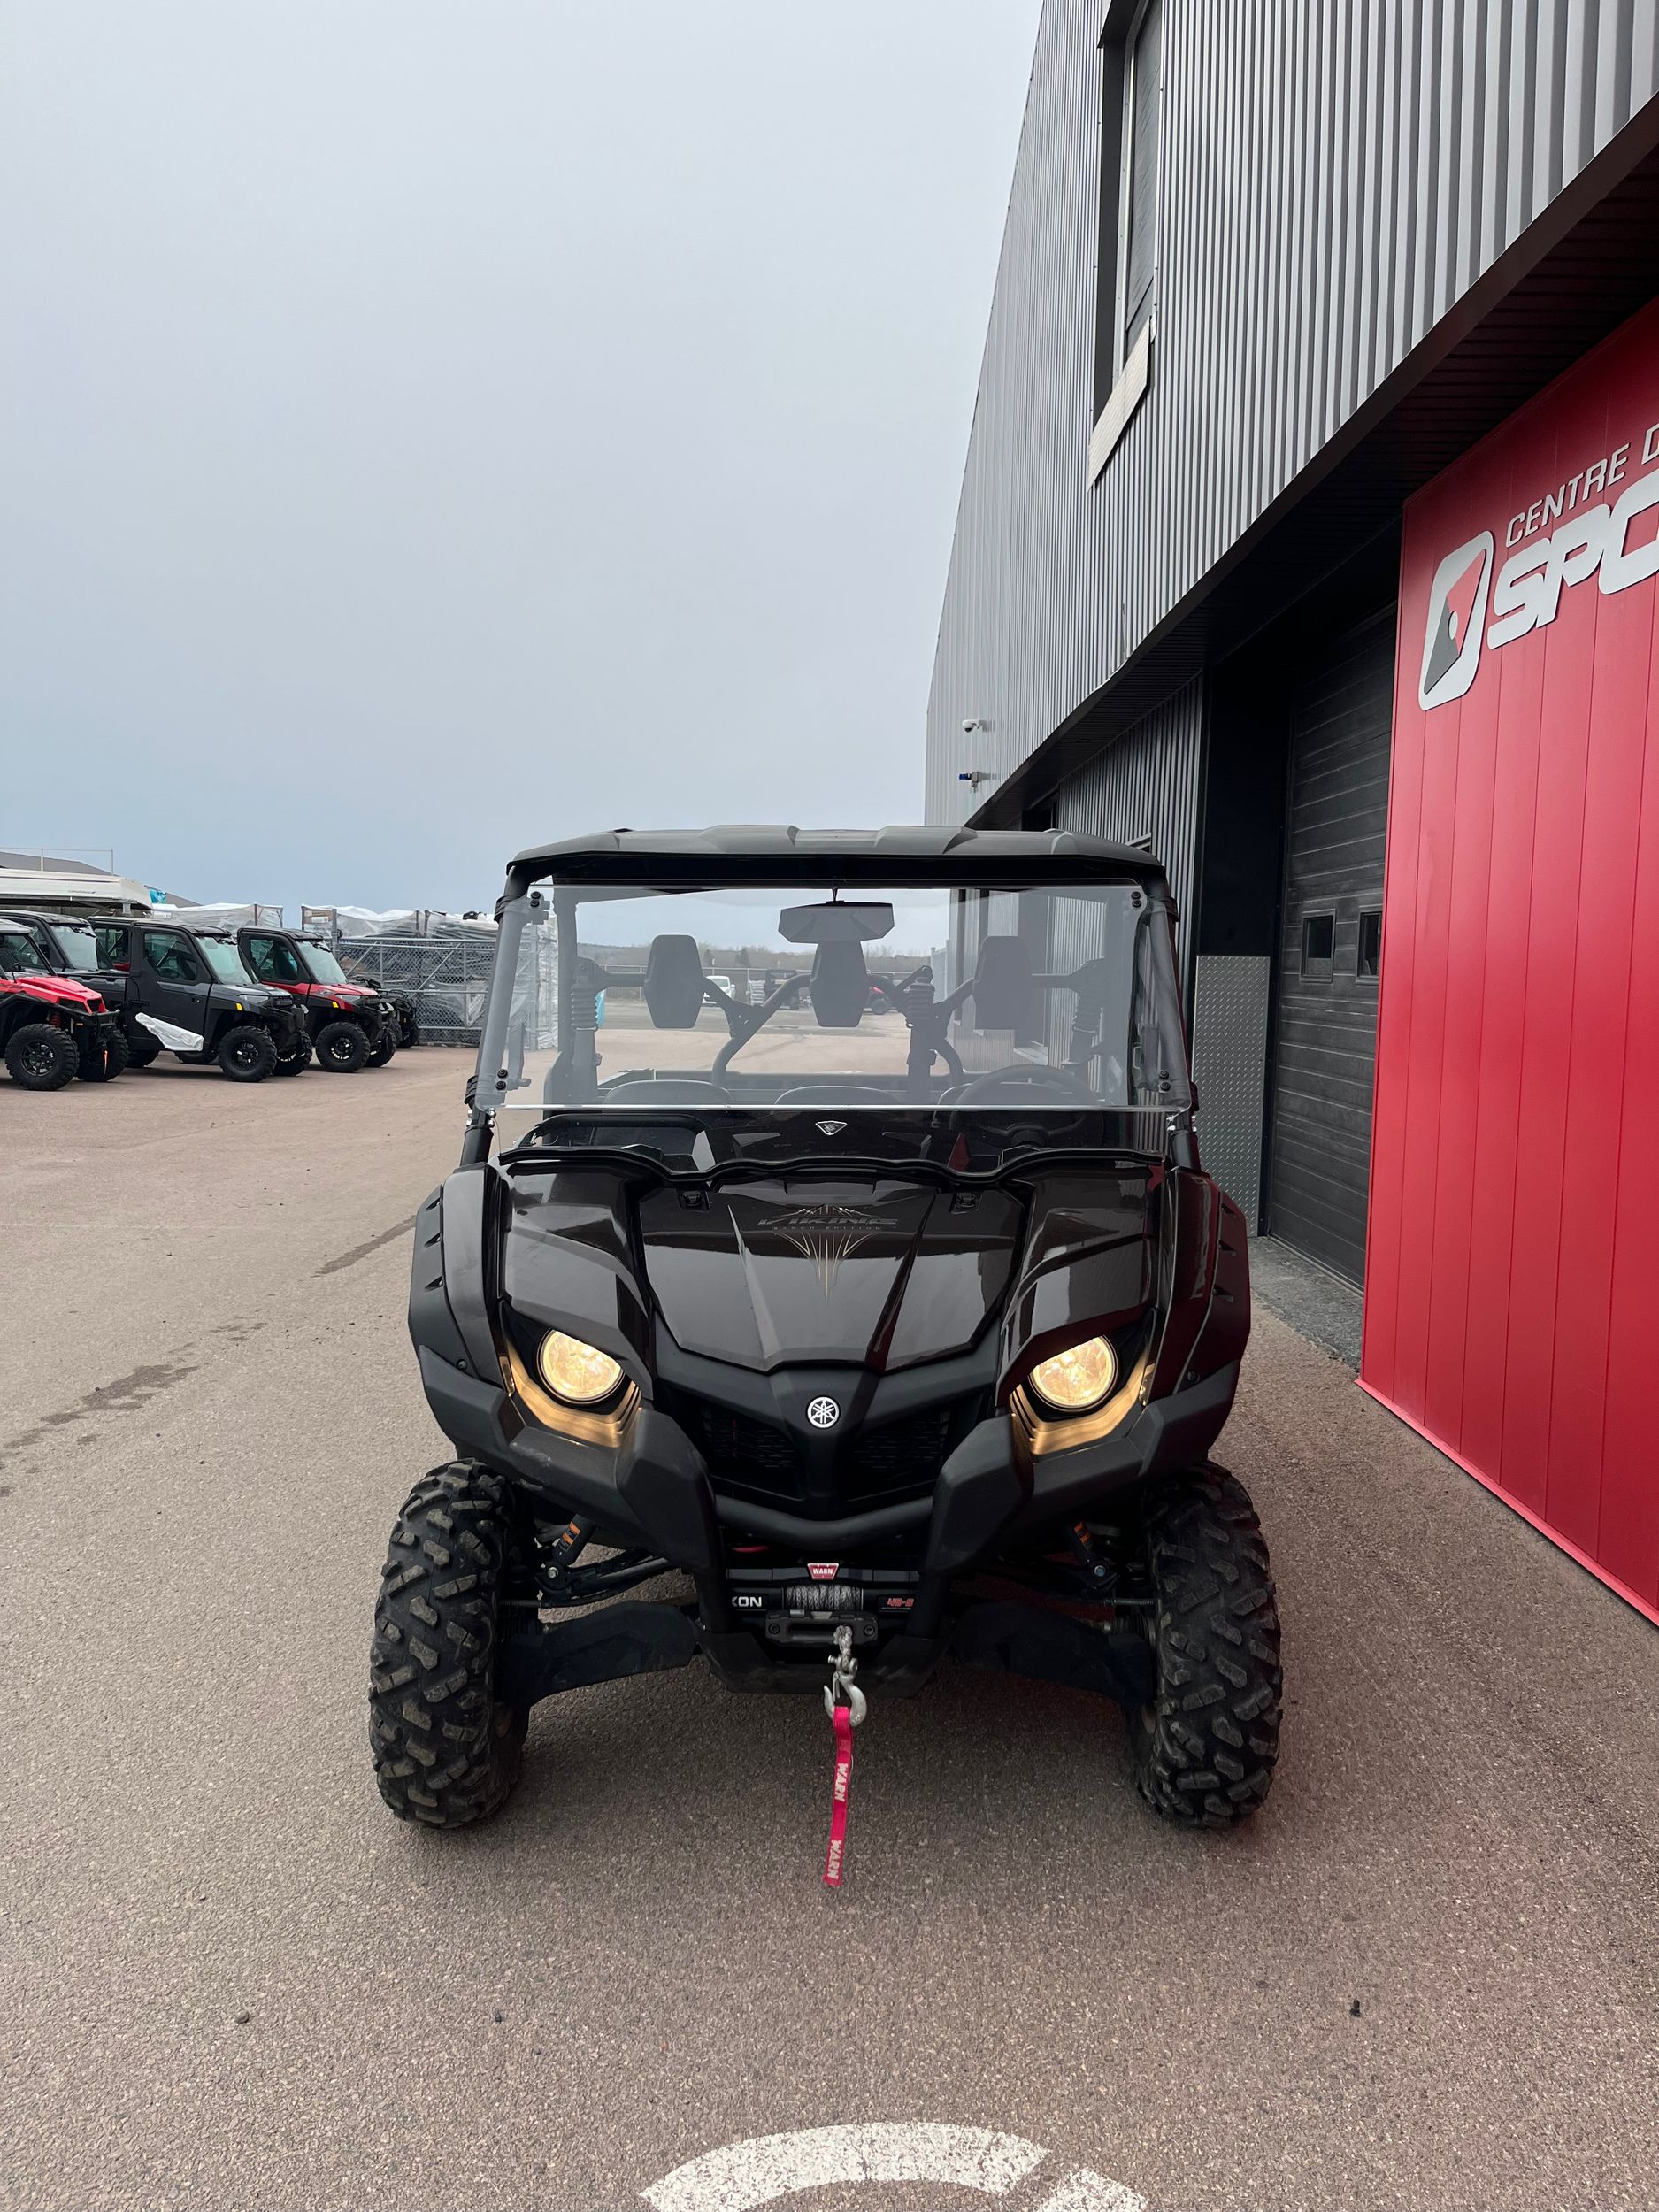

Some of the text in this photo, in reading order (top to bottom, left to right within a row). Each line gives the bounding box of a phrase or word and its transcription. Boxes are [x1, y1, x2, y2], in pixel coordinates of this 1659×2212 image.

[1506, 443, 1631, 548] CENTRE
[834, 1763, 849, 1802] WARN
[826, 1839, 842, 1880] WARN
